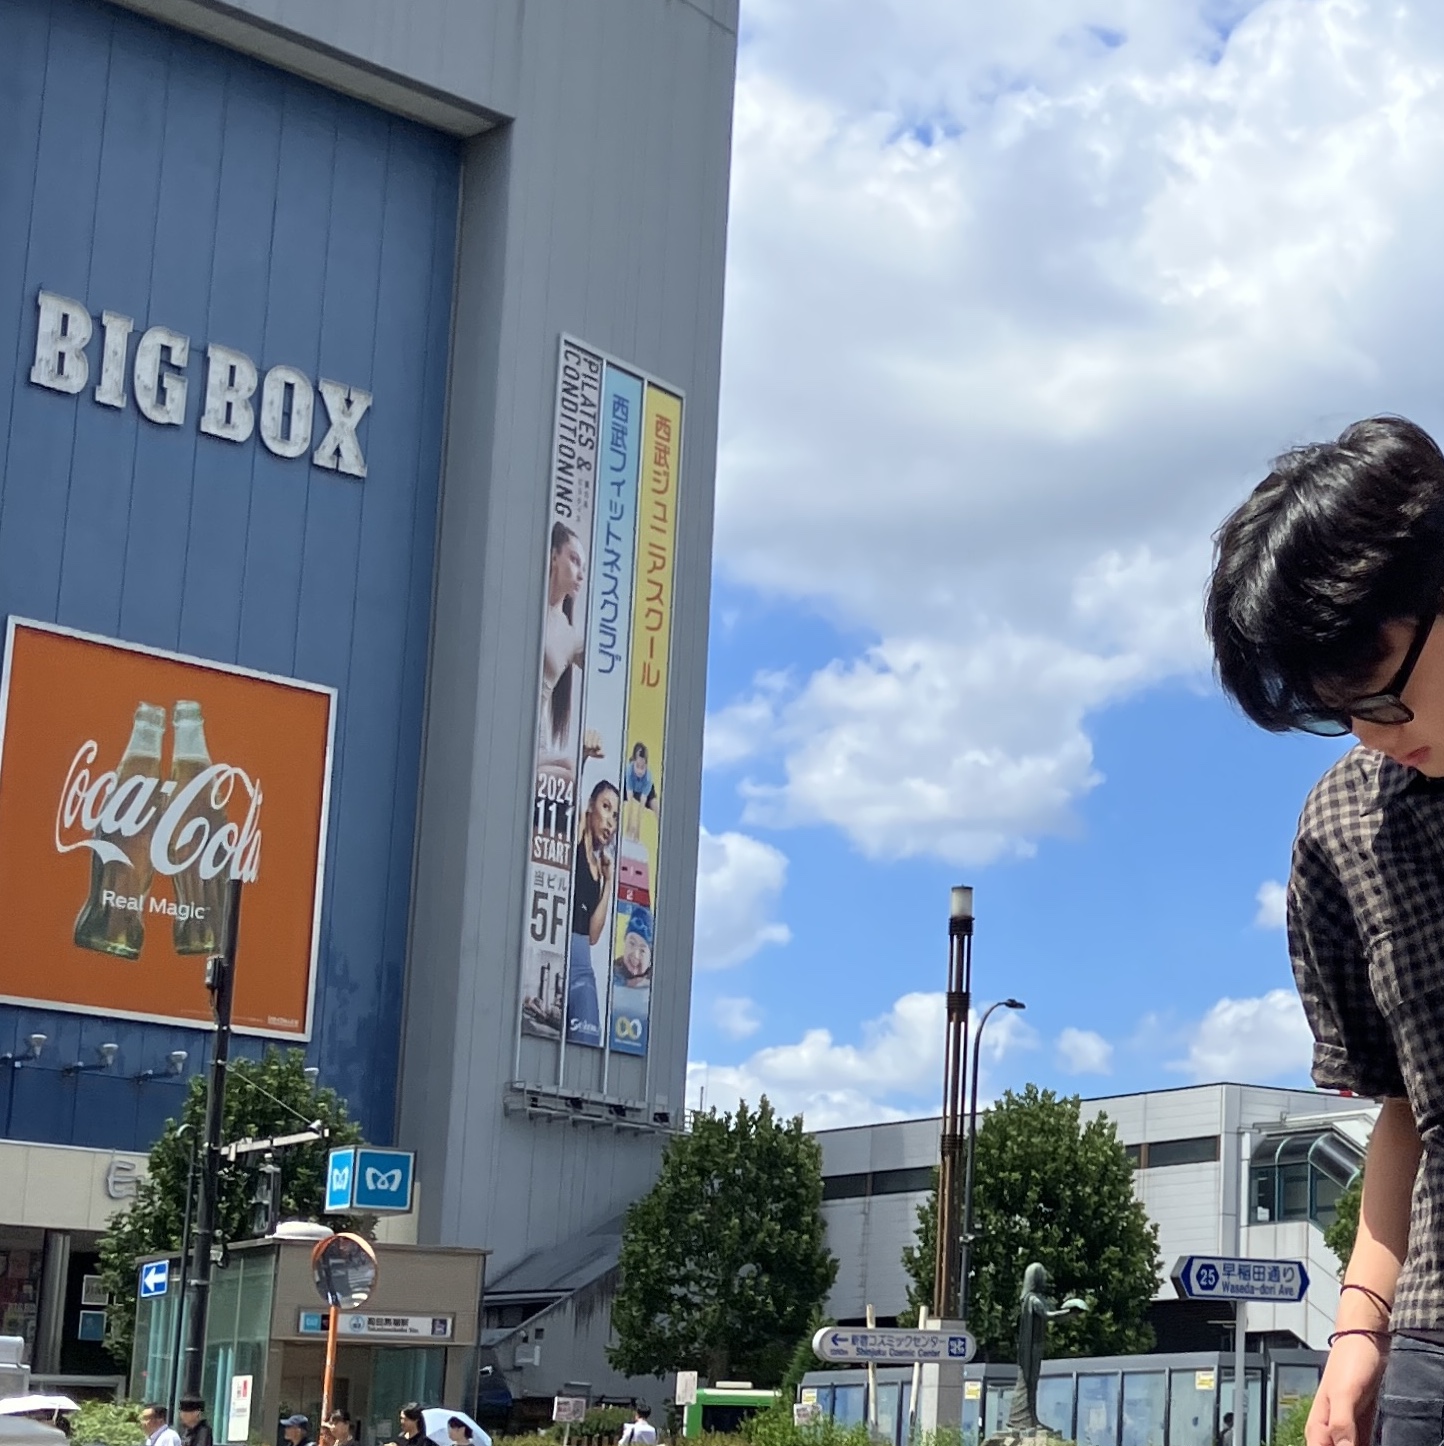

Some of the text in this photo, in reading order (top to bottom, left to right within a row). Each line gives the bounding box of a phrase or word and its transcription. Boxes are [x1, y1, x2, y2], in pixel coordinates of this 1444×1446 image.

[30, 290, 373, 478] BIG BOX
[578, 356, 600, 451] PILATES
[555, 349, 581, 519] CONDITIONING
[577, 456, 592, 473] &
[538, 773, 574, 805] 2024
[56, 739, 263, 883] Coca-Cola
[534, 836, 571, 866] START
[102, 888, 206, 922] Real Magic
[530, 890, 567, 945] 5F
[1200, 1268, 1216, 1286] 25
[1222, 1262, 1295, 1283] 早稲田通り
[1222, 1281, 1276, 1295] Waseda-dori
